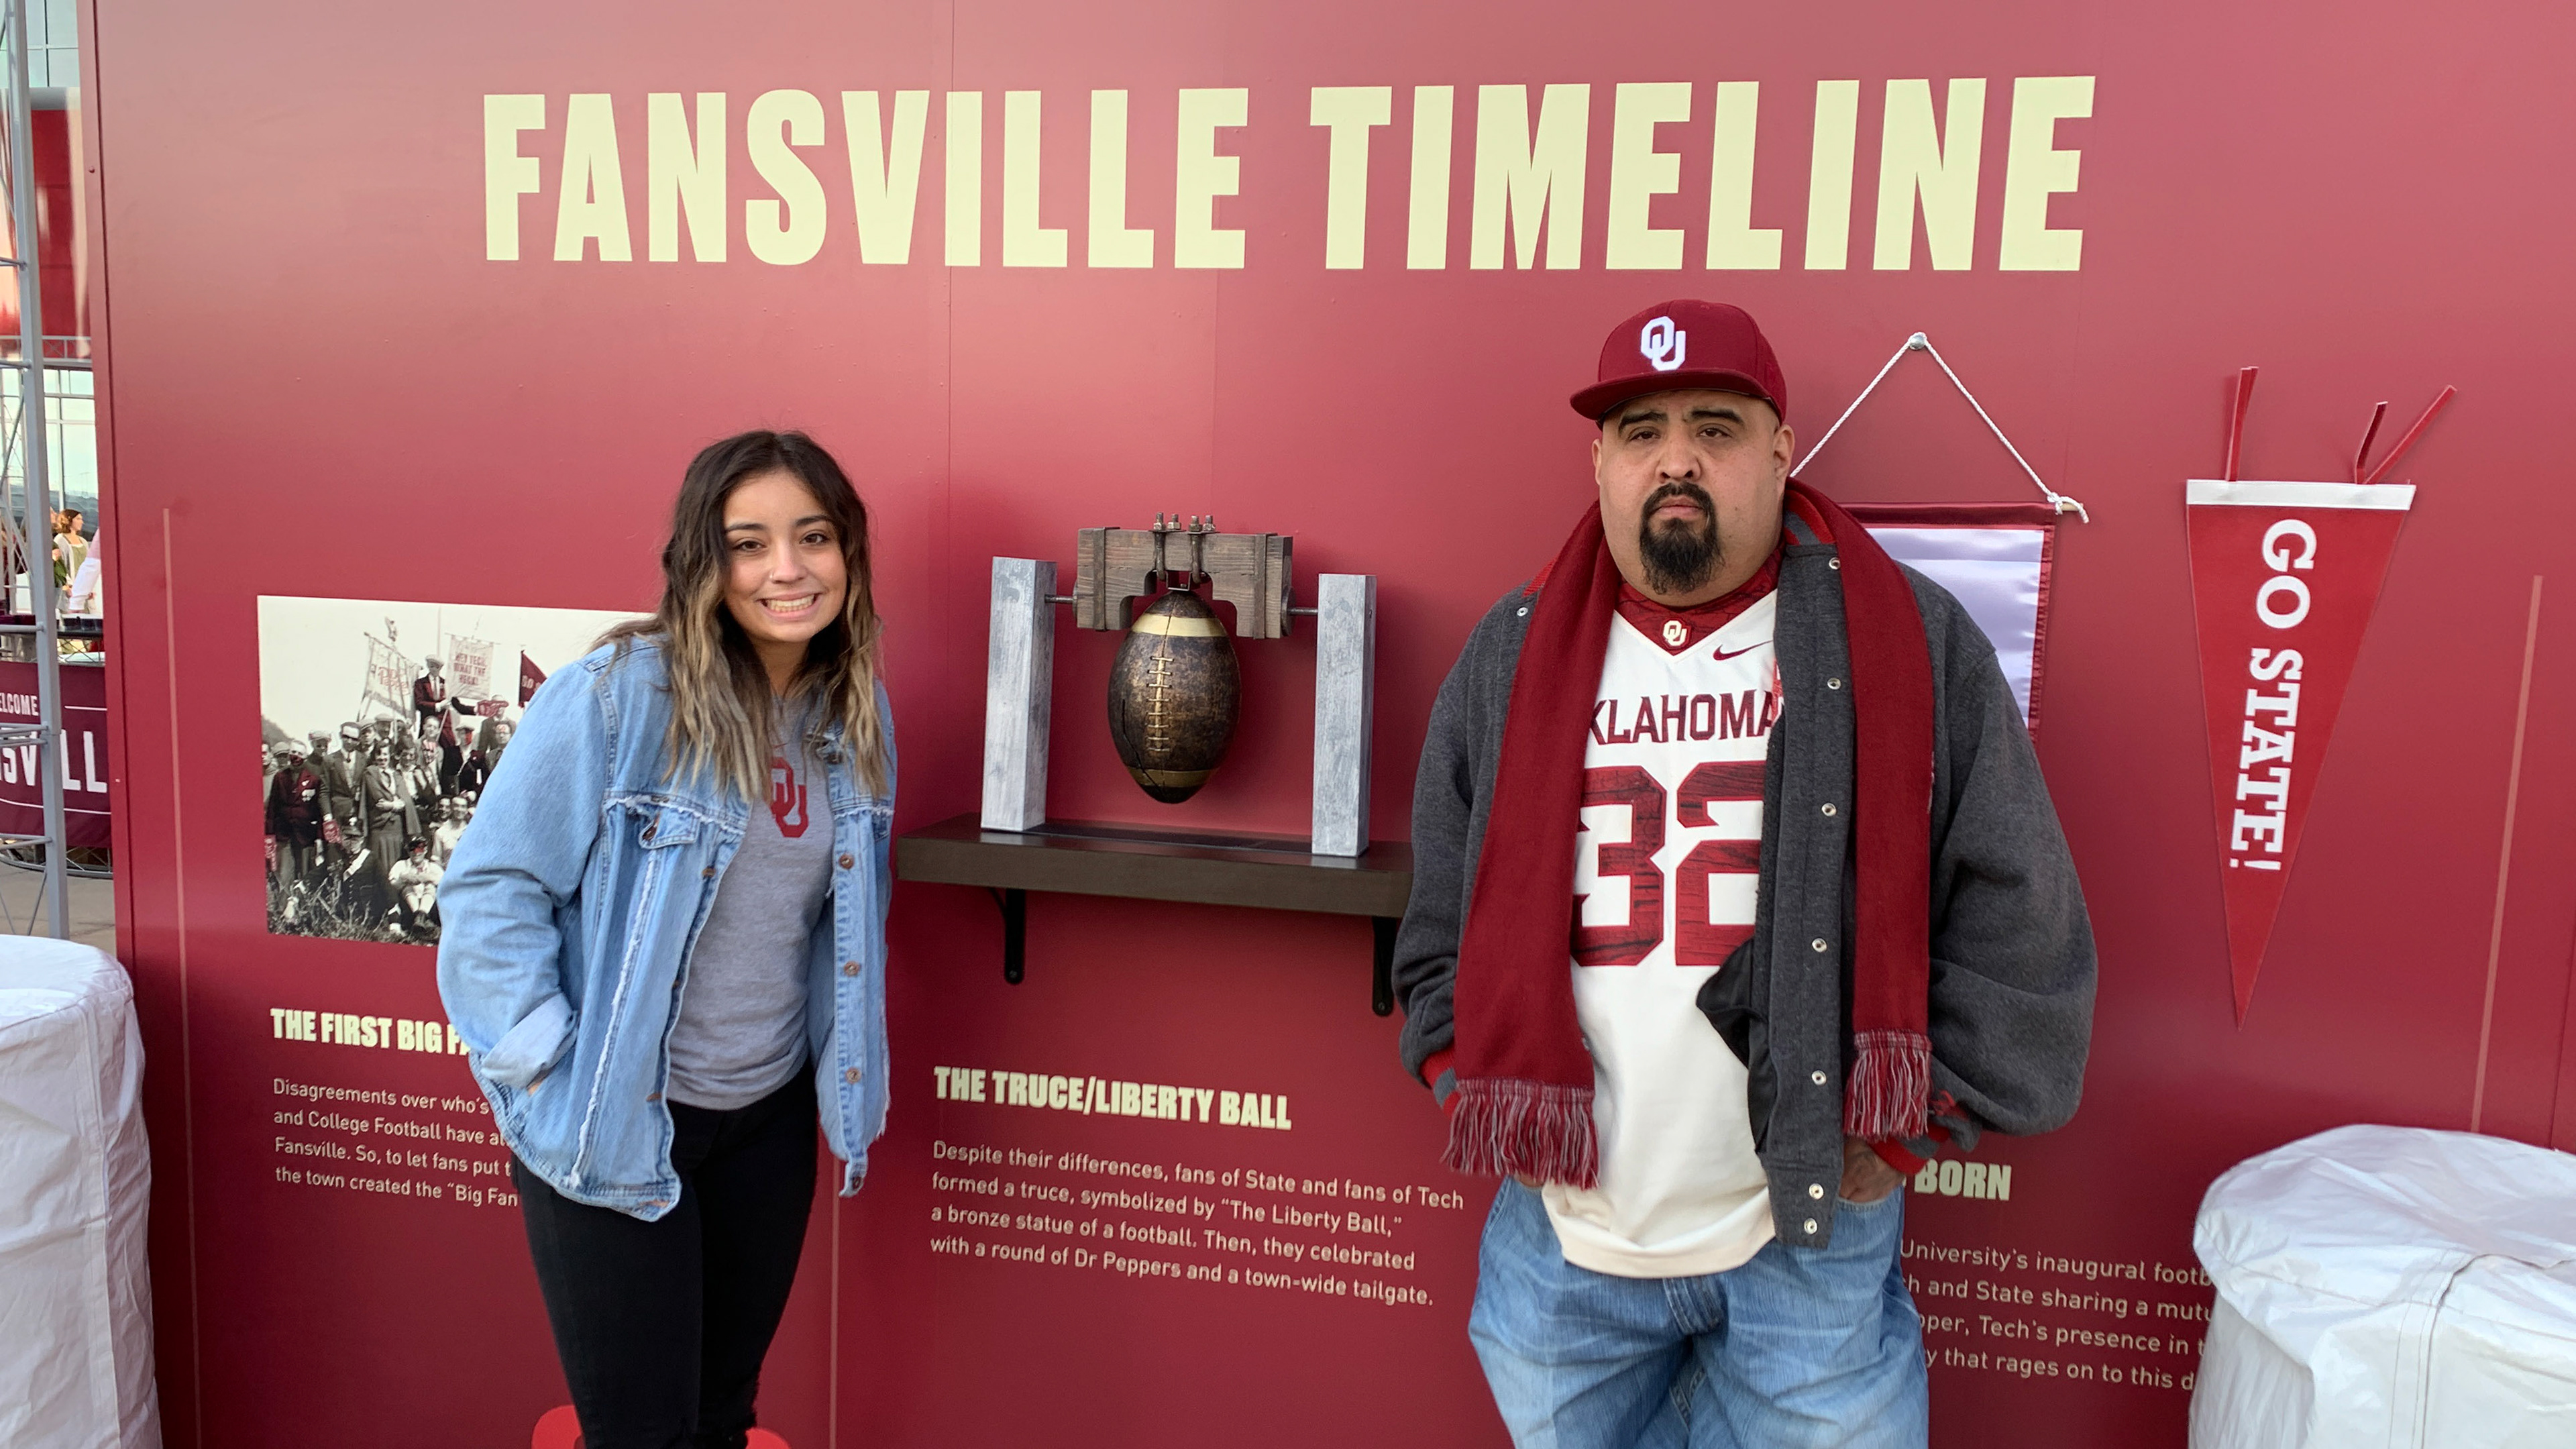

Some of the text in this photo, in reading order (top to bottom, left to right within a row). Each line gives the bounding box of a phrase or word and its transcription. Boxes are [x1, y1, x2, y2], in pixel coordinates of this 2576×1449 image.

[484, 76, 2096, 271] FANSVILLE TIMELINE
[1641, 316, 1686, 371] OU
[1662, 620, 1689, 647] OU
[0, 692, 39, 716] LCOME
[2230, 519, 2317, 871] GO STATE!
[1570, 761, 1767, 967] 32
[270, 1008, 317, 1042] THE
[321, 1012, 392, 1049] FIRST
[397, 1019, 443, 1054] BIG
[274, 1078, 489, 1115] Disagreements over who's
[934, 1067, 1292, 1130] THE TRUCE/LIBERTY BALL
[274, 1110, 303, 1125] and
[309, 1111, 369, 1135] College
[375, 1117, 441, 1140] Football
[447, 1124, 484, 1145] have
[275, 1136, 351, 1161] Fansville.
[356, 1144, 382, 1165] So,
[386, 1149, 402, 1165] to
[407, 1150, 427, 1168] let
[433, 1152, 468, 1172] fans
[473, 1160, 500, 1177] put
[934, 1140, 1464, 1210] Despite their differences, fans of State and fans of Tech
[276, 1167, 518, 1208] the town created the "Big Fan
[1915, 1159, 2012, 1201] BORN
[932, 1171, 1402, 1238] formed a truce, symbolized by "The Liberty Ball,"
[931, 1204, 1415, 1271] a bronze statue of a football. Then, they celebrated
[930, 1235, 1434, 1306] with a round of Dr Peppers and a town-wide tailgate.
[1900, 1238, 2028, 1272] University's
[2037, 1251, 2146, 1281] inaugural
[1928, 1279, 1968, 1299] and
[1976, 1280, 2034, 1305] State
[2041, 1287, 2127, 1320] sharing
[2136, 1300, 2149, 1316] a
[1979, 1315, 2048, 1341] Tech's
[2056, 1328, 2160, 1352] presence
[2169, 1334, 2189, 1356] in
[1945, 1347, 1988, 1370] that
[1996, 1355, 2059, 1379] rages
[2067, 1363, 2094, 1381] on
[2102, 1362, 2123, 1383] to
[2131, 1365, 2174, 1389] this
